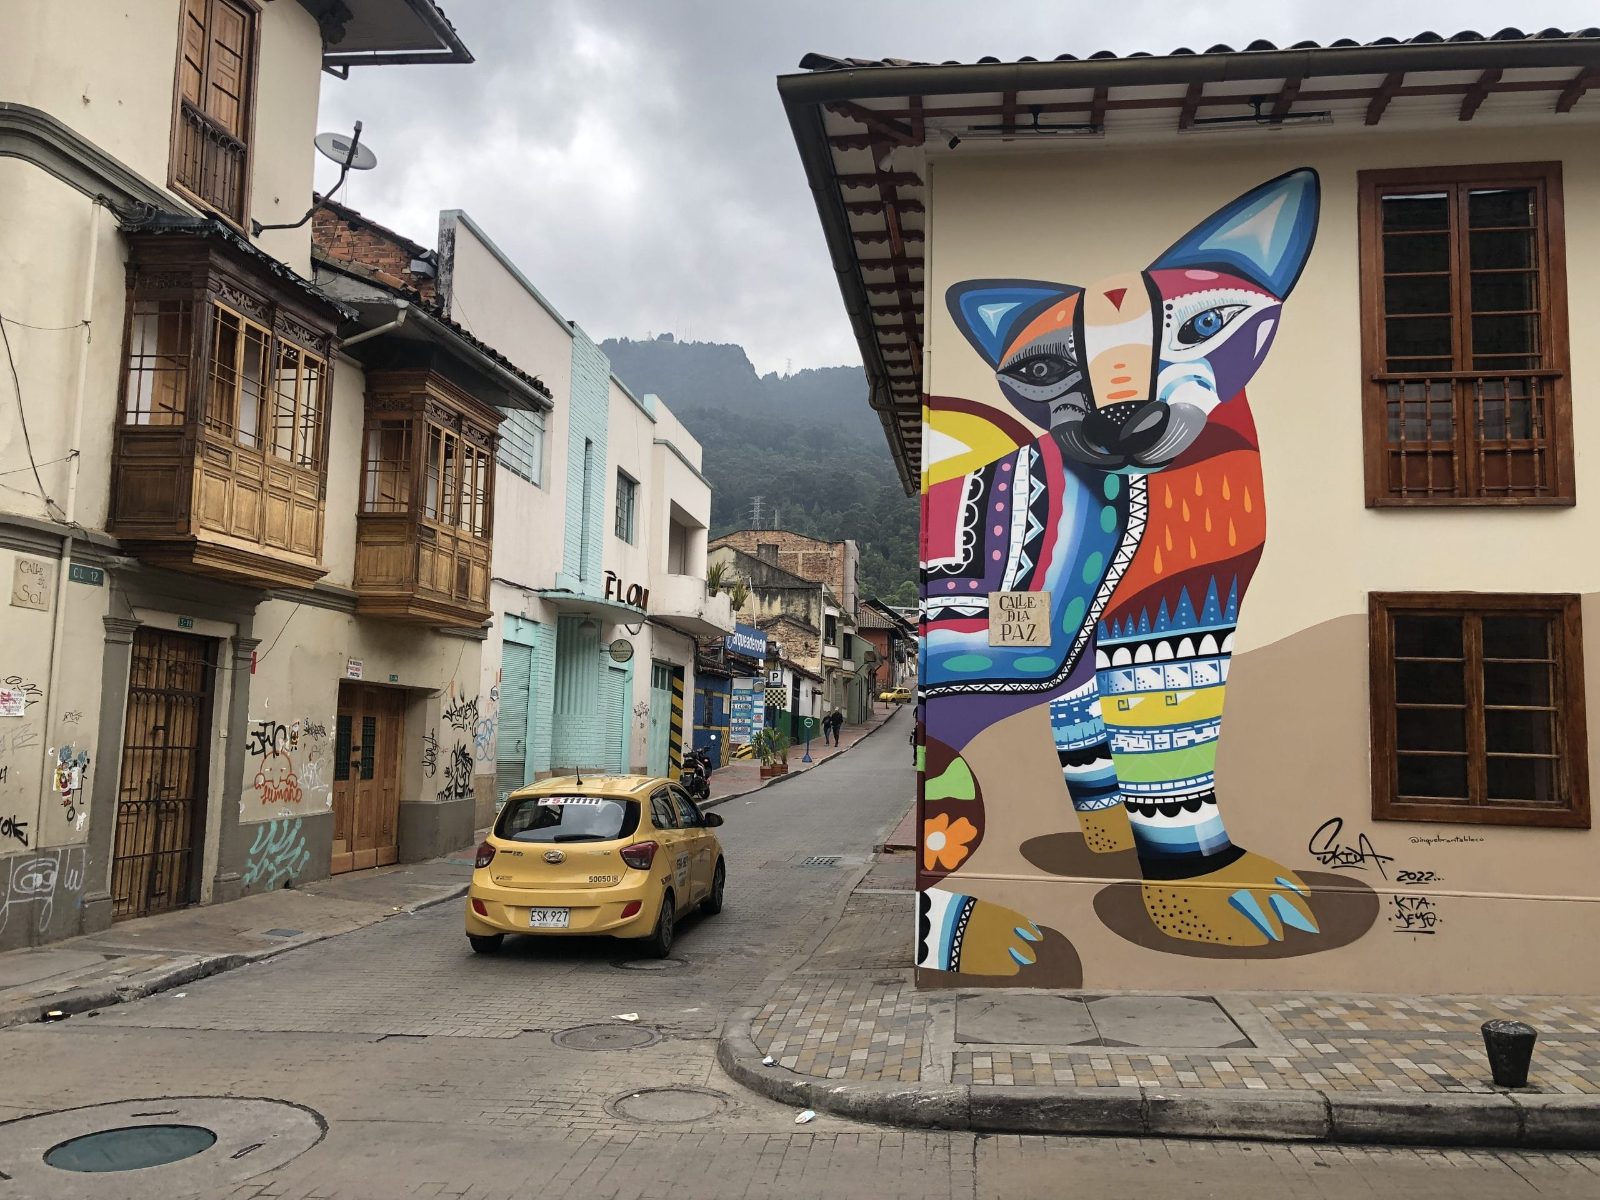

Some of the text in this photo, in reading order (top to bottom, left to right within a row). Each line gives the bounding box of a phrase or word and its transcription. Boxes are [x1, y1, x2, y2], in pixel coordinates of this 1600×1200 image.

[73, 567, 99, 582] CL 12
[13, 584, 46, 605] SOL
[999, 594, 1037, 612] CALLE
[999, 623, 1037, 642] PAZ
[772, 672, 779, 682] P
[530, 910, 569, 922] ESK 927
